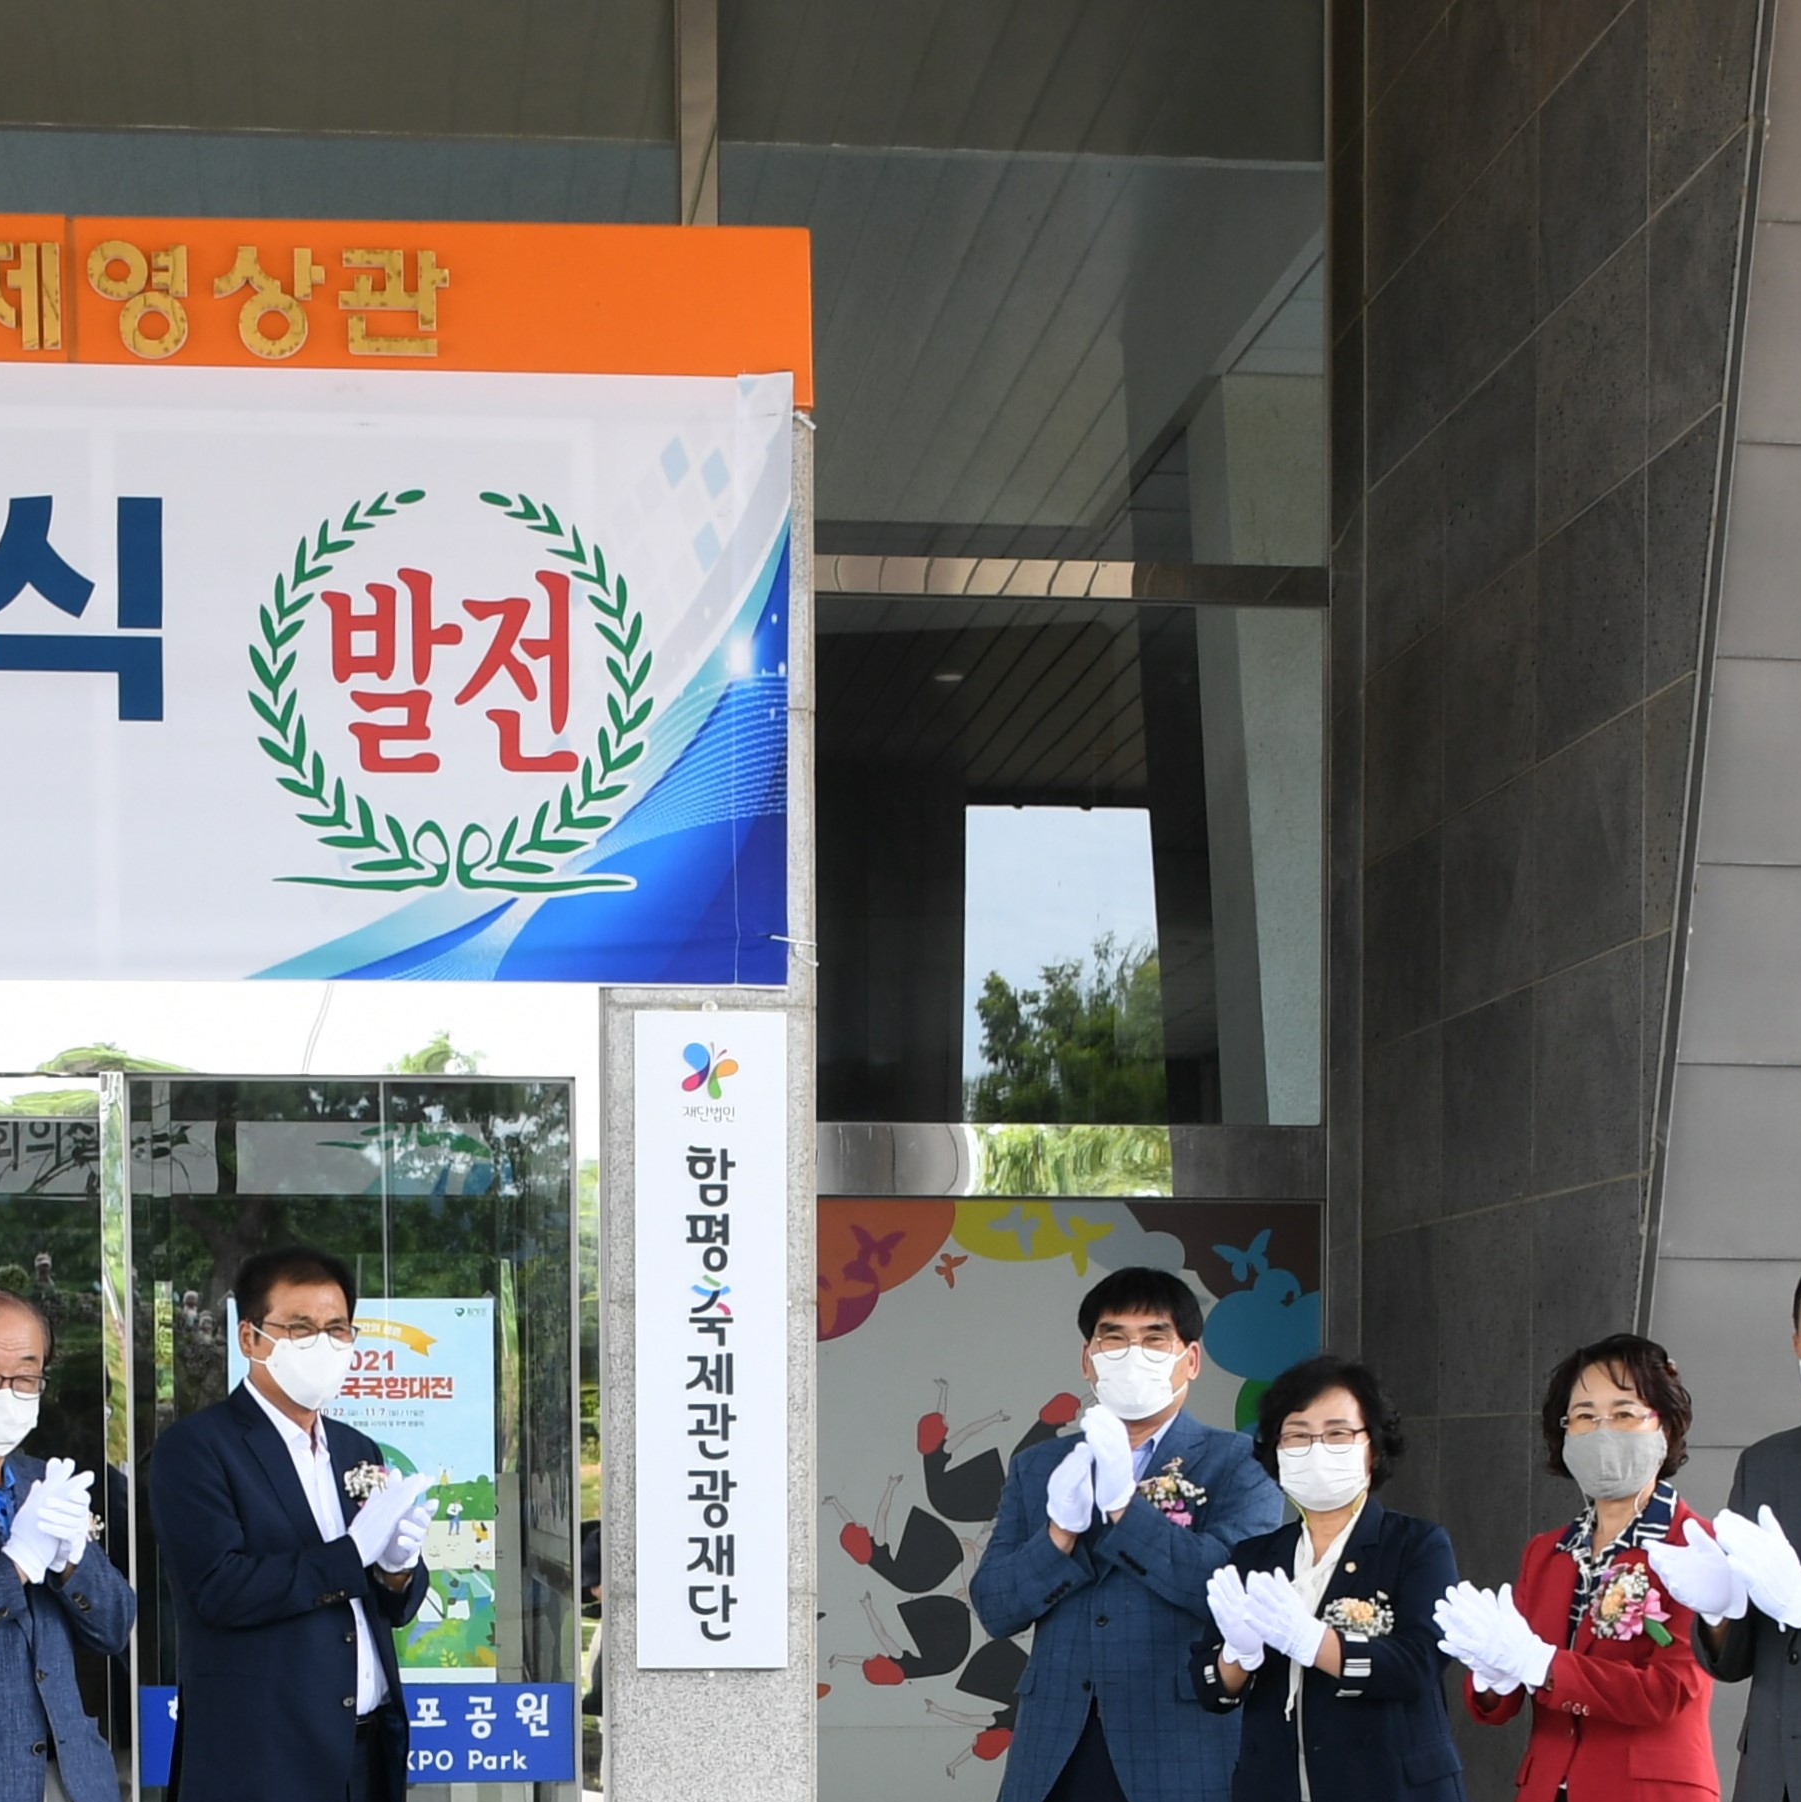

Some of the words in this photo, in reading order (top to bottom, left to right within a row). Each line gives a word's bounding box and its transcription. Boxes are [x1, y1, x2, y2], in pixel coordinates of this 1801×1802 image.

[322, 567, 580, 773] 발전
[683, 1105, 736, 1122] 재단법인
[349, 1350, 394, 1372] 021
[335, 1376, 454, 1400] 국국향대전
[468, 1749, 528, 1771] Park
